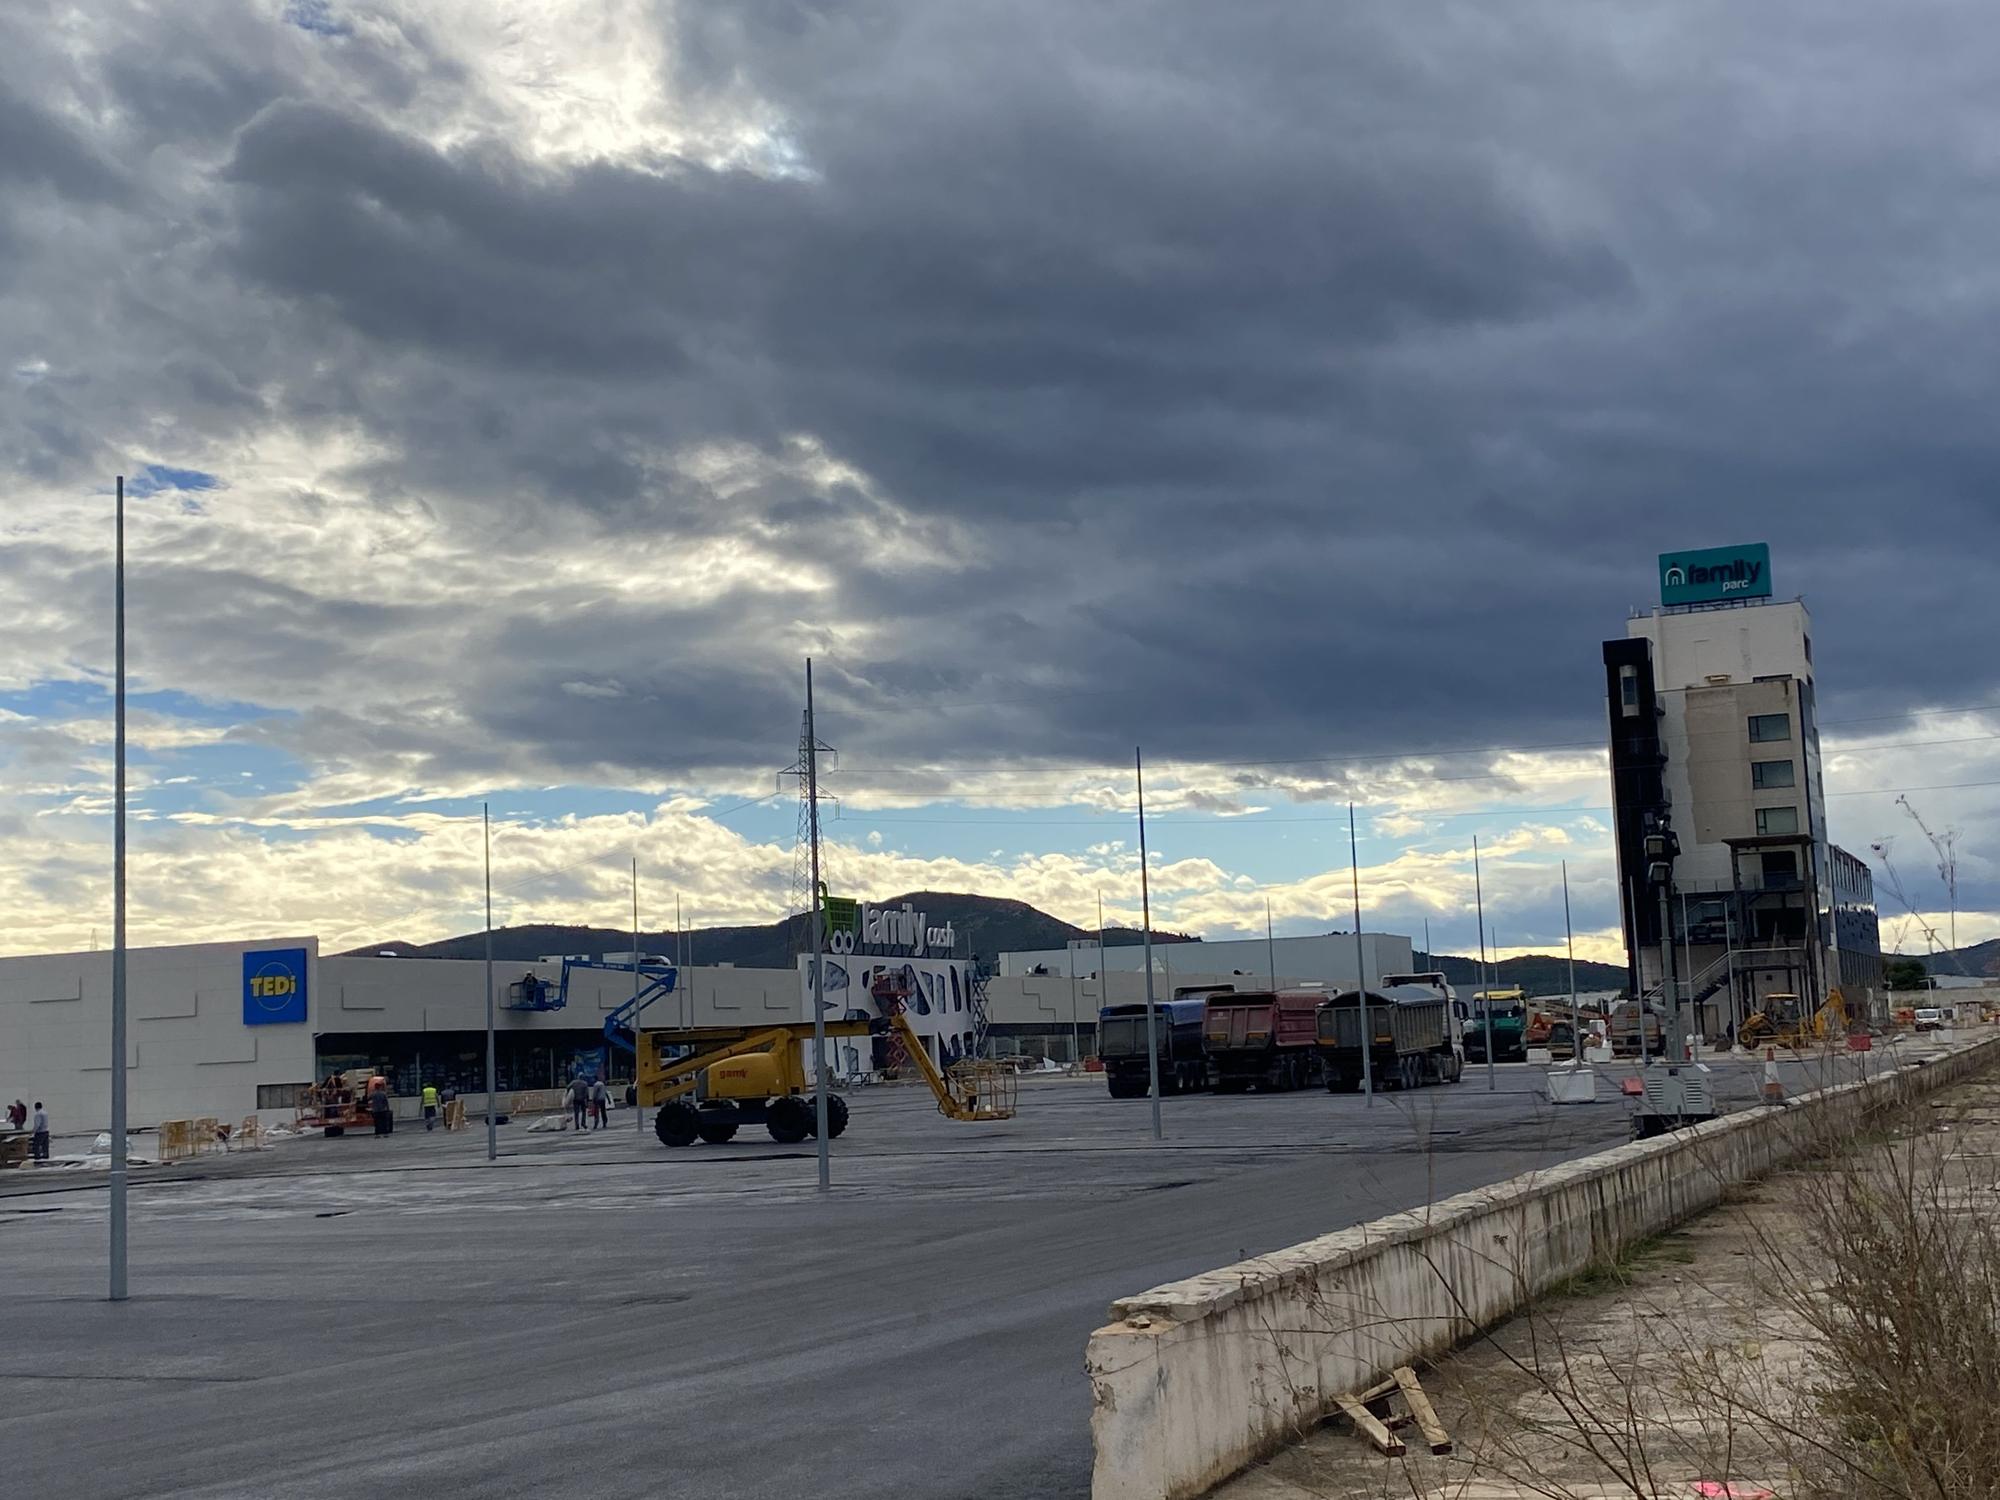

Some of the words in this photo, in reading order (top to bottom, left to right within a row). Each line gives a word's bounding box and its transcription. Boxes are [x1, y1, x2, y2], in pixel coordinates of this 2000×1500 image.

[1688, 559, 1762, 585] family
[1722, 578, 1749, 592] parc
[862, 901, 926, 956] family
[926, 921, 955, 947] cash
[250, 975, 296, 997] TEDi
